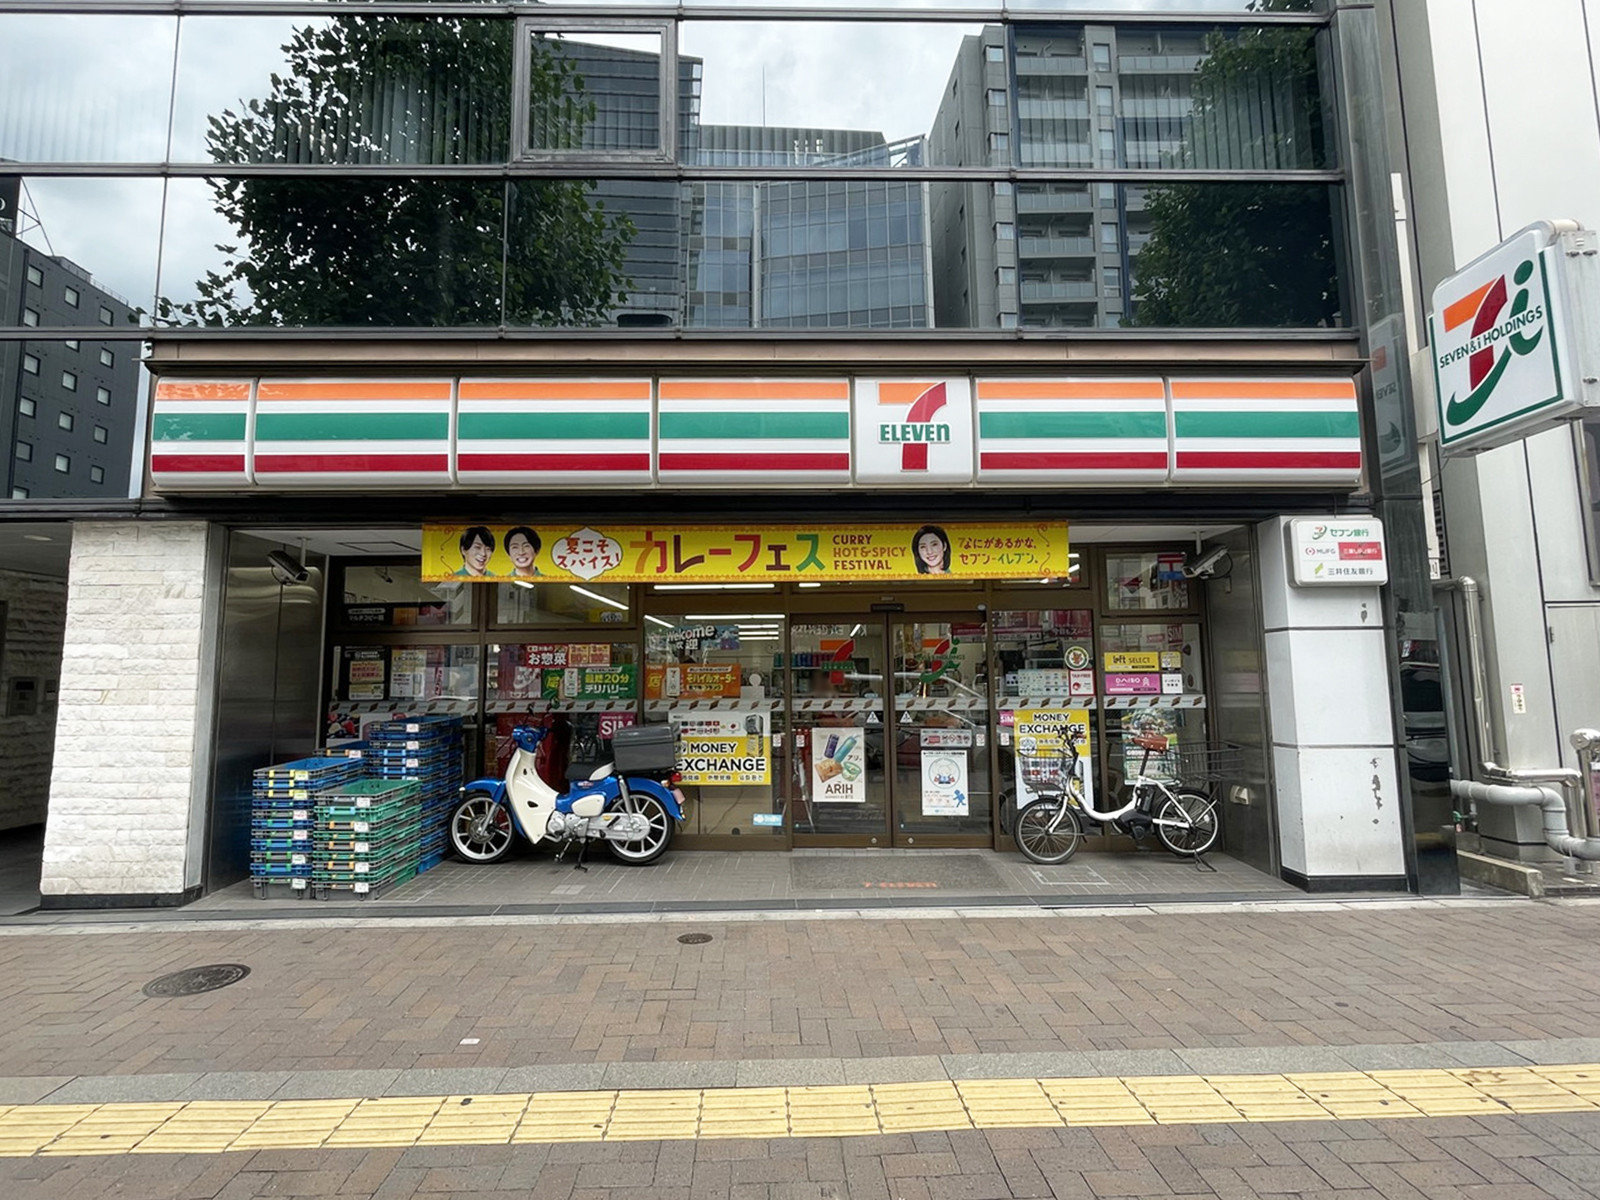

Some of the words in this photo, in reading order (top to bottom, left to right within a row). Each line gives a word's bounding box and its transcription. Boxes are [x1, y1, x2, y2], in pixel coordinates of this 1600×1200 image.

[1483, 305, 1543, 347] HOLDINGS
[1329, 528, 1369, 537] セブン銀行
[832, 534, 873, 545] CURRY
[565, 536, 610, 555] 夏こそ
[1316, 547, 1336, 555] MUFG
[629, 530, 826, 574] カレーフェス
[832, 545, 907, 558] HOT&SPICY
[833, 559, 892, 571] FESTIVAL
[1327, 567, 1373, 576] 三井住友銀行
[528, 652, 567, 666] お惣菜
[585, 684, 629, 694] デリバリー
[1033, 713, 1070, 722] MONEY
[690, 743, 737, 753] MONEY
[674, 758, 766, 771] EXCHANGE
[825, 784, 854, 794] ARIH
